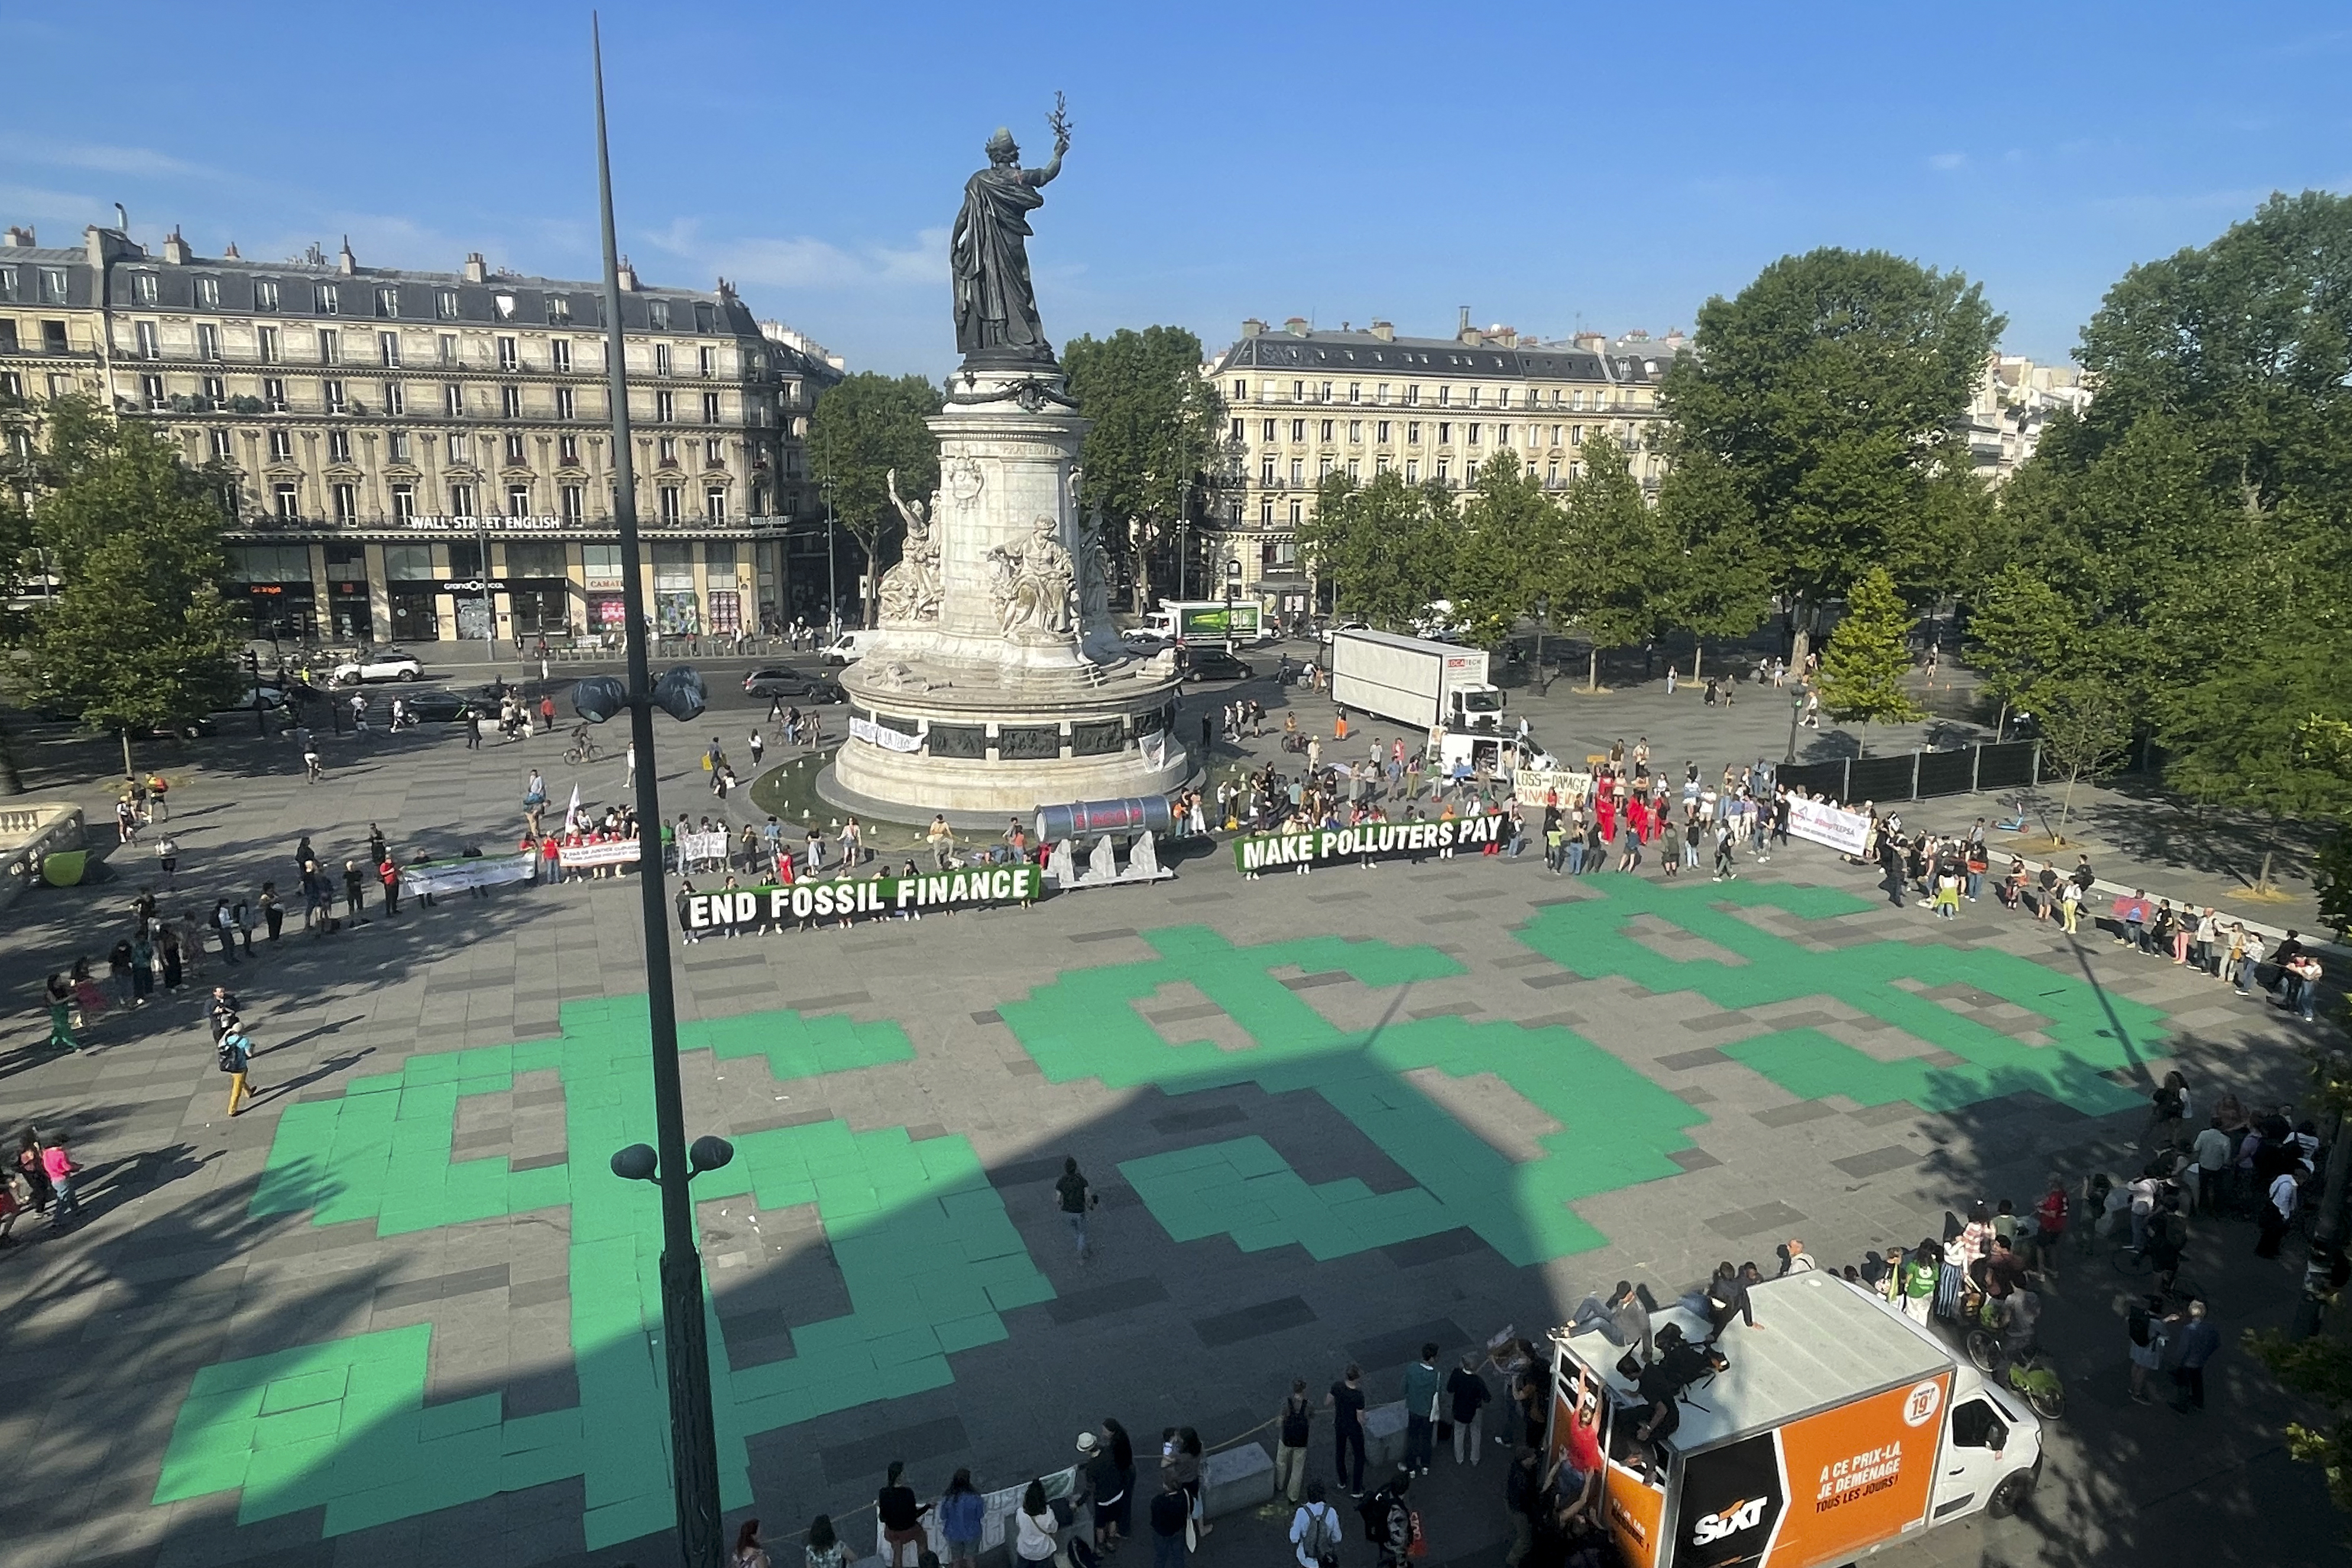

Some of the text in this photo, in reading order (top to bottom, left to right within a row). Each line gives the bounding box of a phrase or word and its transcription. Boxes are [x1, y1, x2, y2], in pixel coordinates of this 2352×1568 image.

[412, 516, 449, 529] WALL
[506, 516, 561, 529] ENGLISH
[1515, 771, 1587, 792] LOSS DAMAGE
[1243, 815, 1502, 869] MAKE POLLUTERS PAY
[689, 869, 1030, 928] END FOSSIL FINANCE
[1832, 1459, 1850, 1478] CE
[1816, 1482, 1833, 1500] JE
[1816, 1495, 1841, 1514] TOUS
[1843, 1488, 1860, 1504] LES
